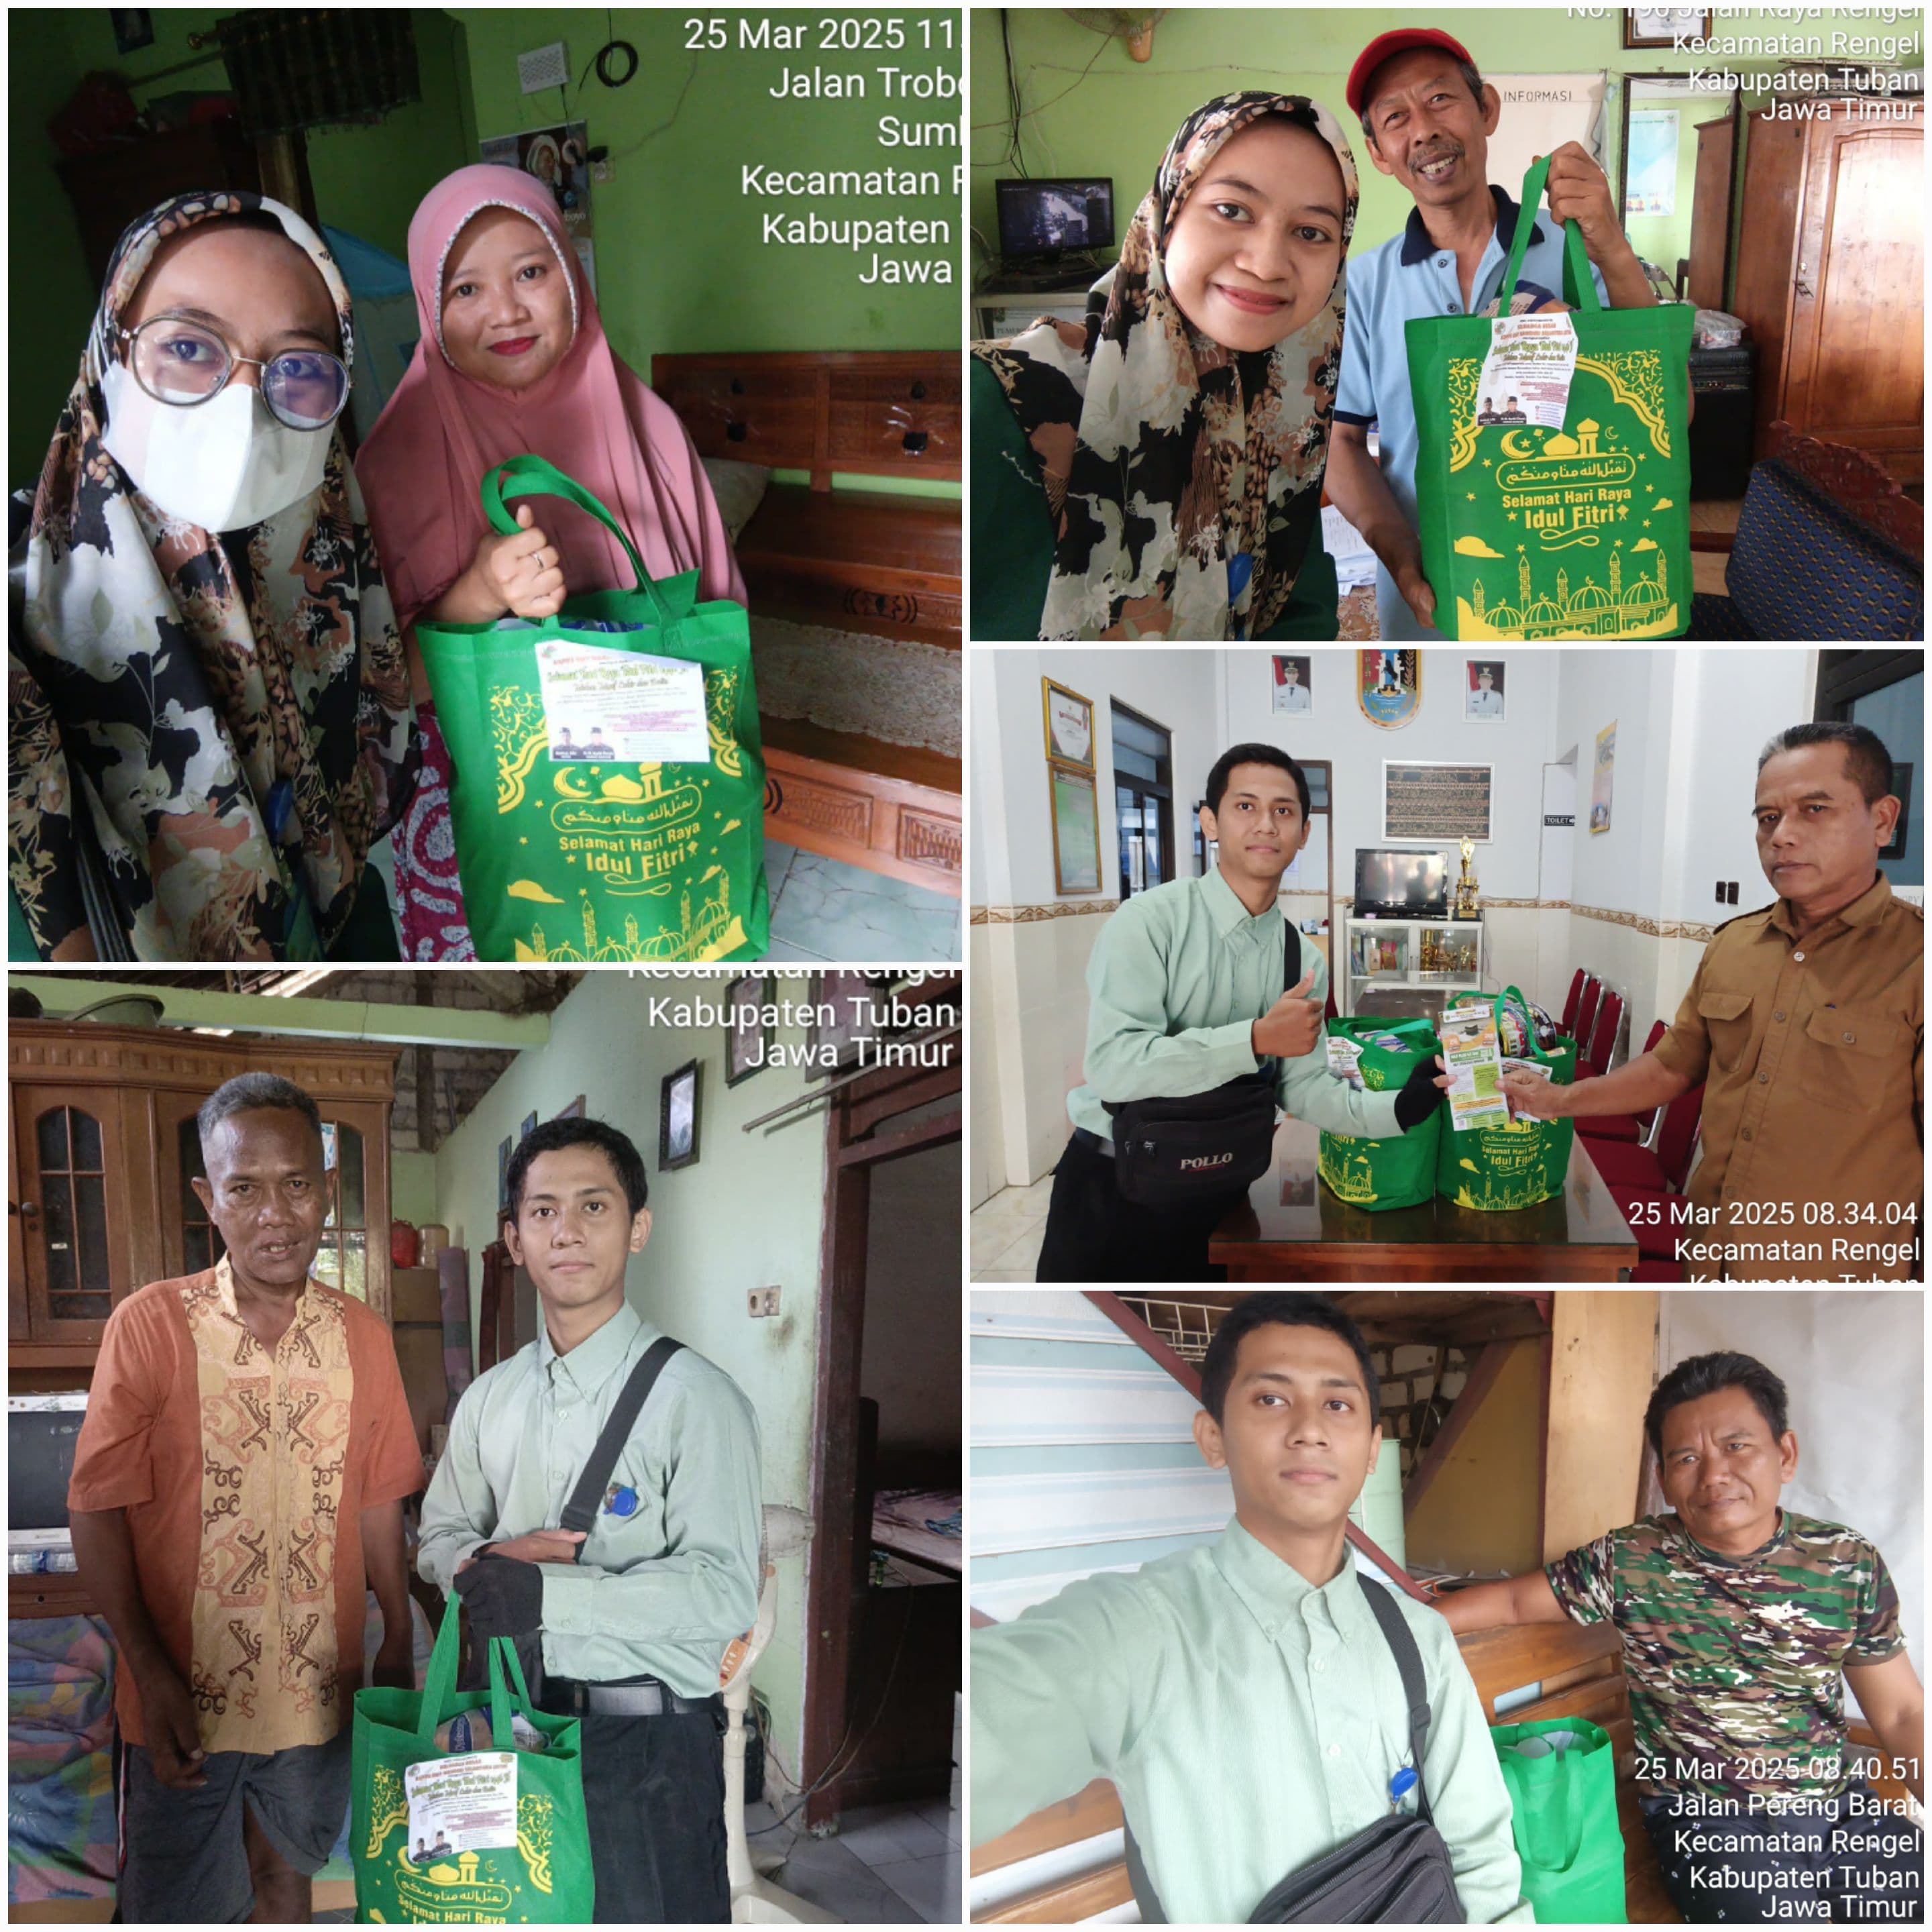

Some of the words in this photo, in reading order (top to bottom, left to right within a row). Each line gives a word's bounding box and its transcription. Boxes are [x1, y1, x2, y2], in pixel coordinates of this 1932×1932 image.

[1503, 91, 1572, 101] INFORMASI
[1502, 492, 1560, 508] Selamat
[1564, 490, 1593, 504] Hari
[1598, 488, 1631, 502] Raya
[1525, 508, 1564, 529] Idul
[1572, 504, 1614, 529] Fitri
[559, 836, 625, 852] Selamat
[631, 834, 663, 851] Hari
[667, 822, 701, 843] Raya
[586, 853, 631, 875] Idul
[641, 843, 685, 879] Fitri
[1481, 1146, 1510, 1154] Selamat
[1180, 1152, 1233, 1170] POLLO
[1491, 1156, 1511, 1165] Idul
[1515, 1154, 1533, 1167] Fitri
[398, 1894, 440, 1922] Selamat
[444, 1911, 471, 1922] Hari
[475, 1912, 506, 1924] Raya
